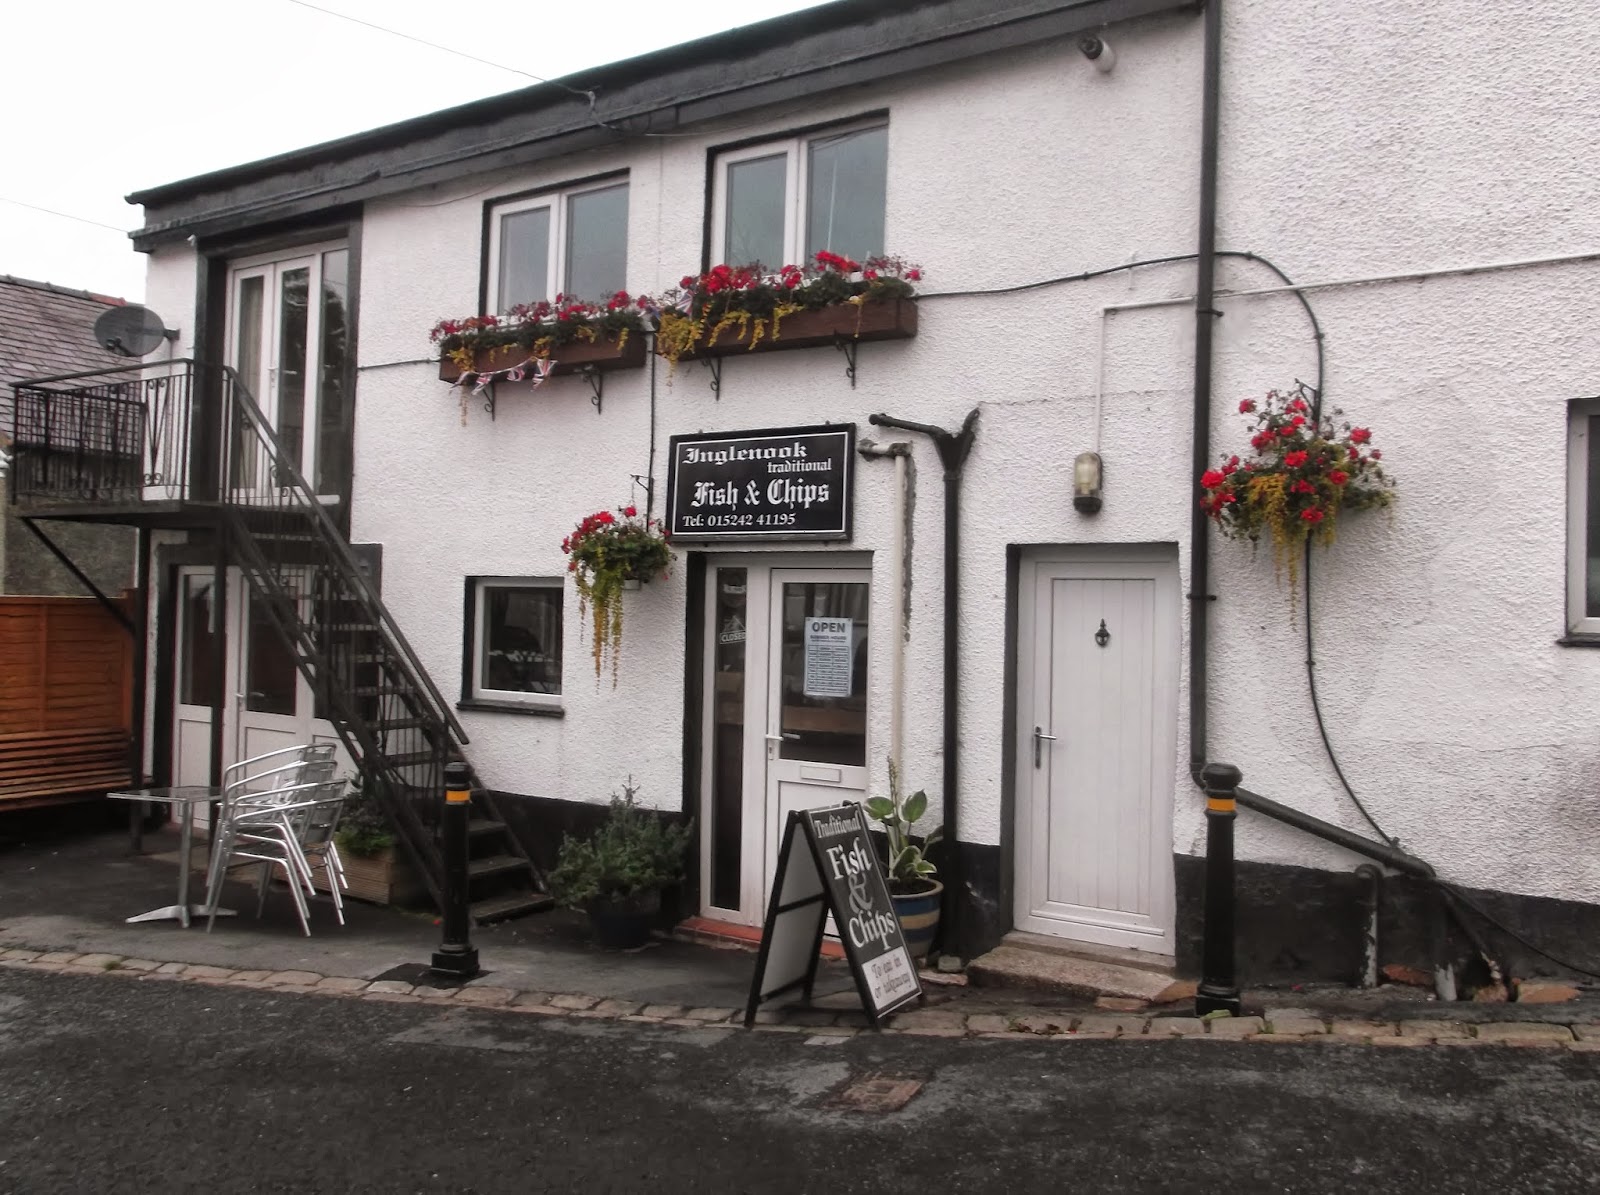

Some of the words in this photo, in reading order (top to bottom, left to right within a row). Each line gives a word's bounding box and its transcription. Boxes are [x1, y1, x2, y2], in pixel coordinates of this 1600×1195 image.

[681, 441, 808, 466] Inglenook
[766, 457, 832, 474] traditional
[690, 481, 739, 511] Fish
[743, 479, 761, 506] &
[766, 477, 830, 510] Chips
[682, 513, 705, 528] Tel:
[706, 513, 754, 527] 015242
[755, 512, 797, 526] 41195
[721, 632, 746, 643] CLOSED
[811, 621, 846, 633] OPEN
[813, 808, 863, 839] Traditional
[826, 836, 873, 880] Fish
[848, 871, 875, 914] &
[848, 908, 896, 951] Chips
